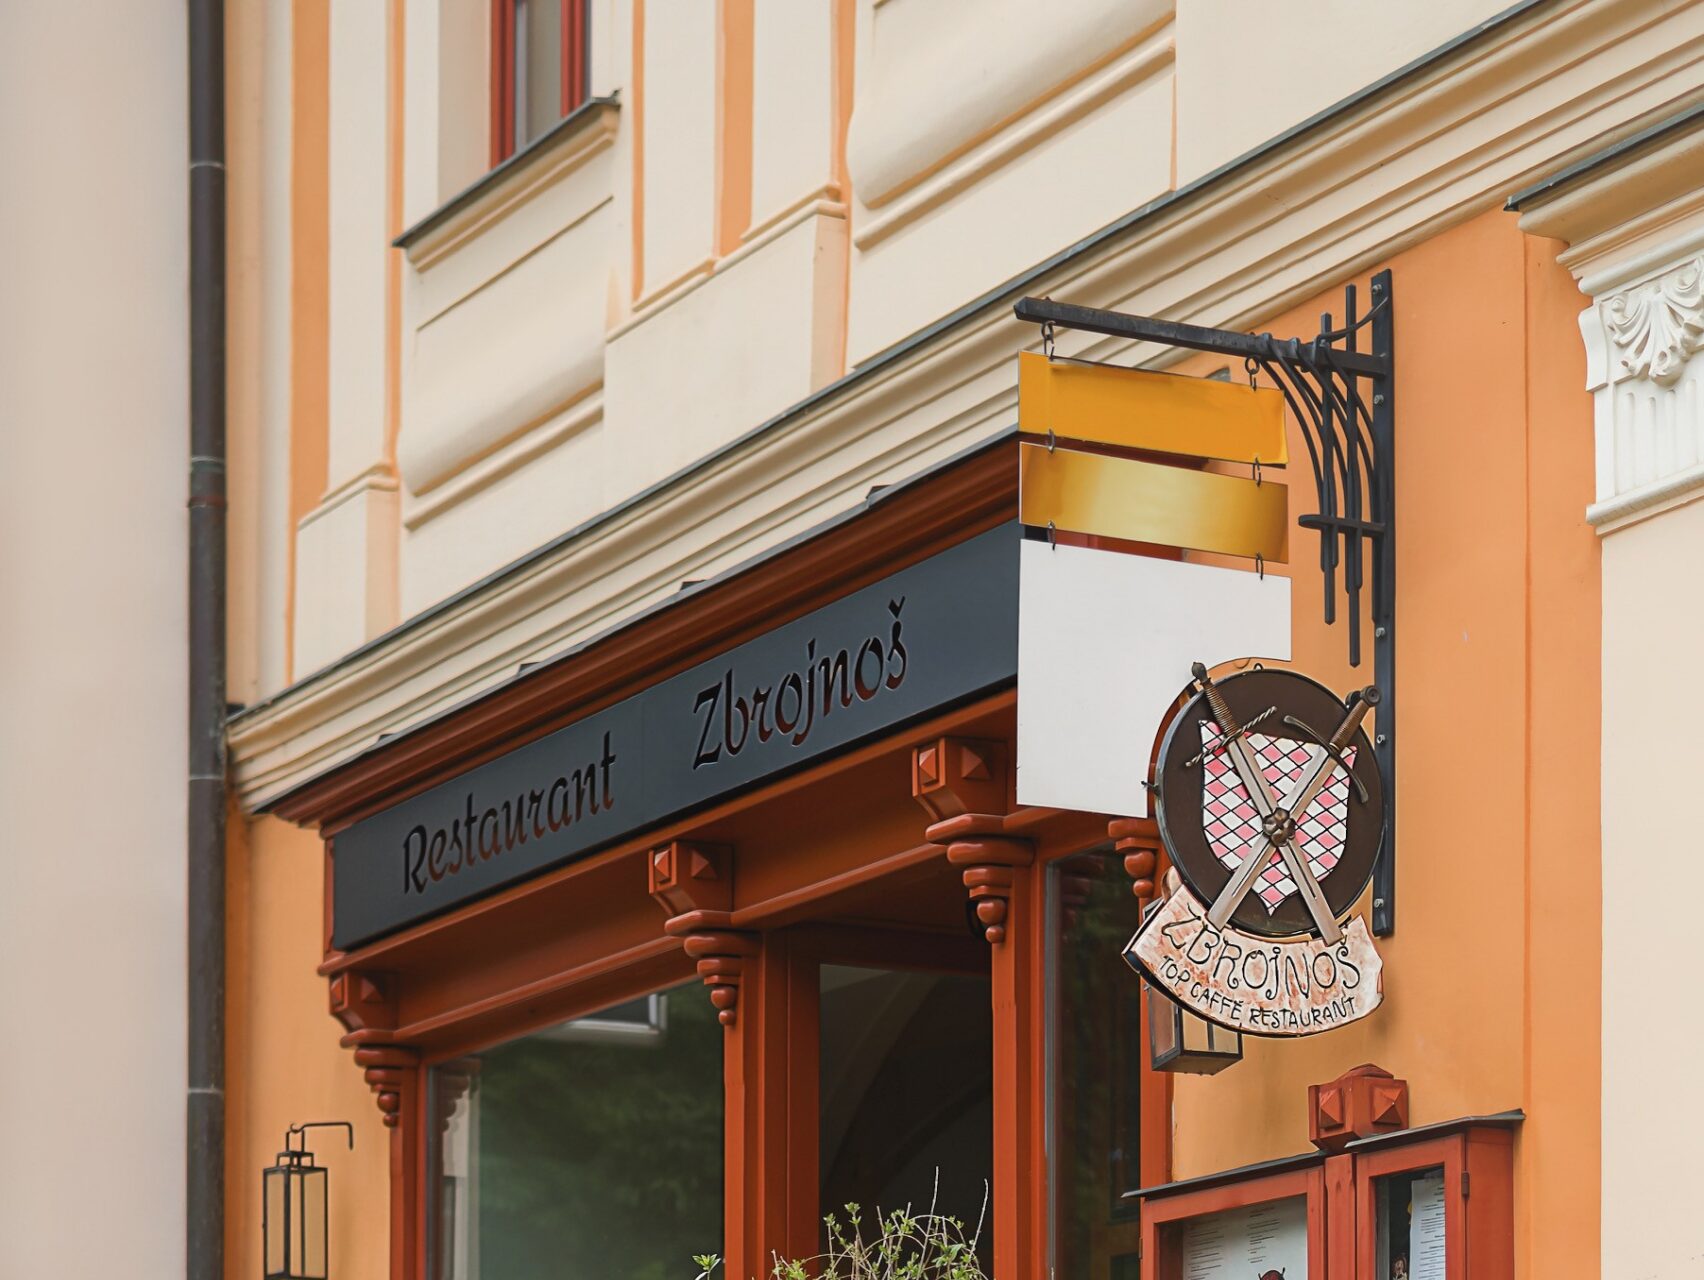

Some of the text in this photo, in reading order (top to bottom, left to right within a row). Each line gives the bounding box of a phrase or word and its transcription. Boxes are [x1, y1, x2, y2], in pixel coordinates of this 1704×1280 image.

[403, 596, 908, 895] Restaurant Zbrojnoš
[1160, 955, 1191, 987] TOP
[1249, 997, 1355, 1029] RESTAURANT
